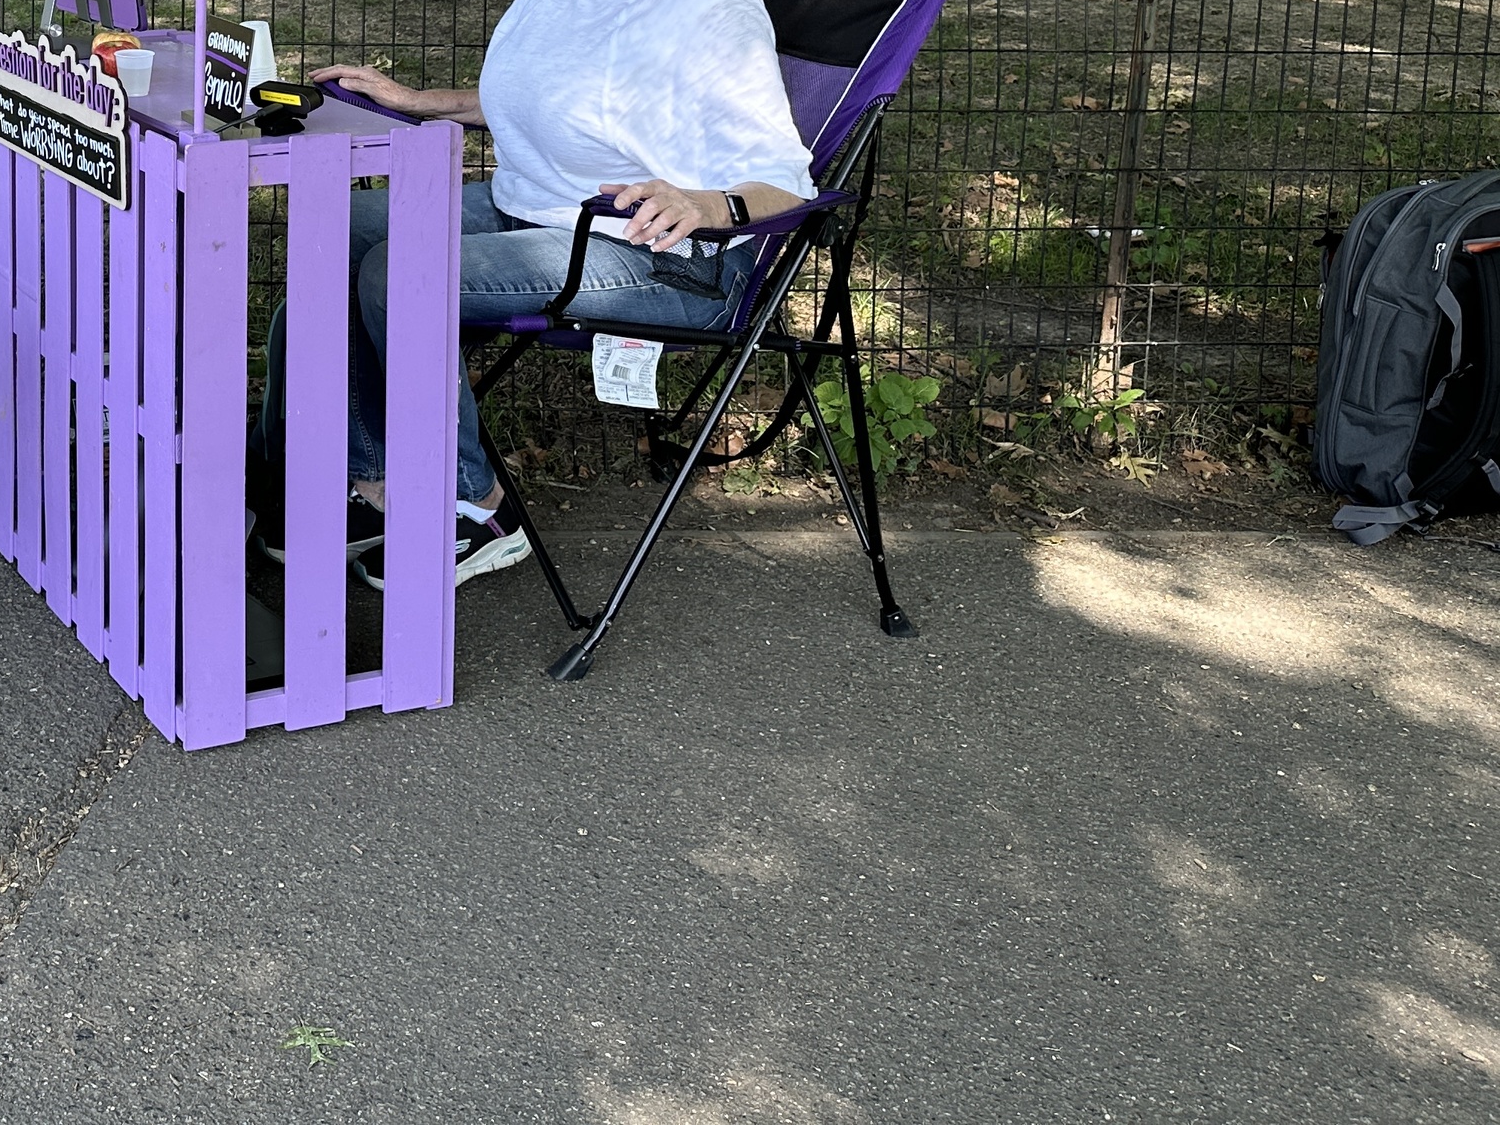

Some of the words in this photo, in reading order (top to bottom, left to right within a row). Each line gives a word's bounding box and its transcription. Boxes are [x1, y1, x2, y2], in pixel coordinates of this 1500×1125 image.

[207, 32, 250, 62] GRANDMA:
[38, 45, 60, 92] for
[60, 56, 85, 104] the
[85, 66, 120, 127] day:
[18, 102, 28, 117] do
[28, 107, 46, 126] you
[47, 115, 72, 138] spend
[74, 130, 88, 148] too
[89, 139, 115, 159] much
[76, 149, 116, 190] about?
